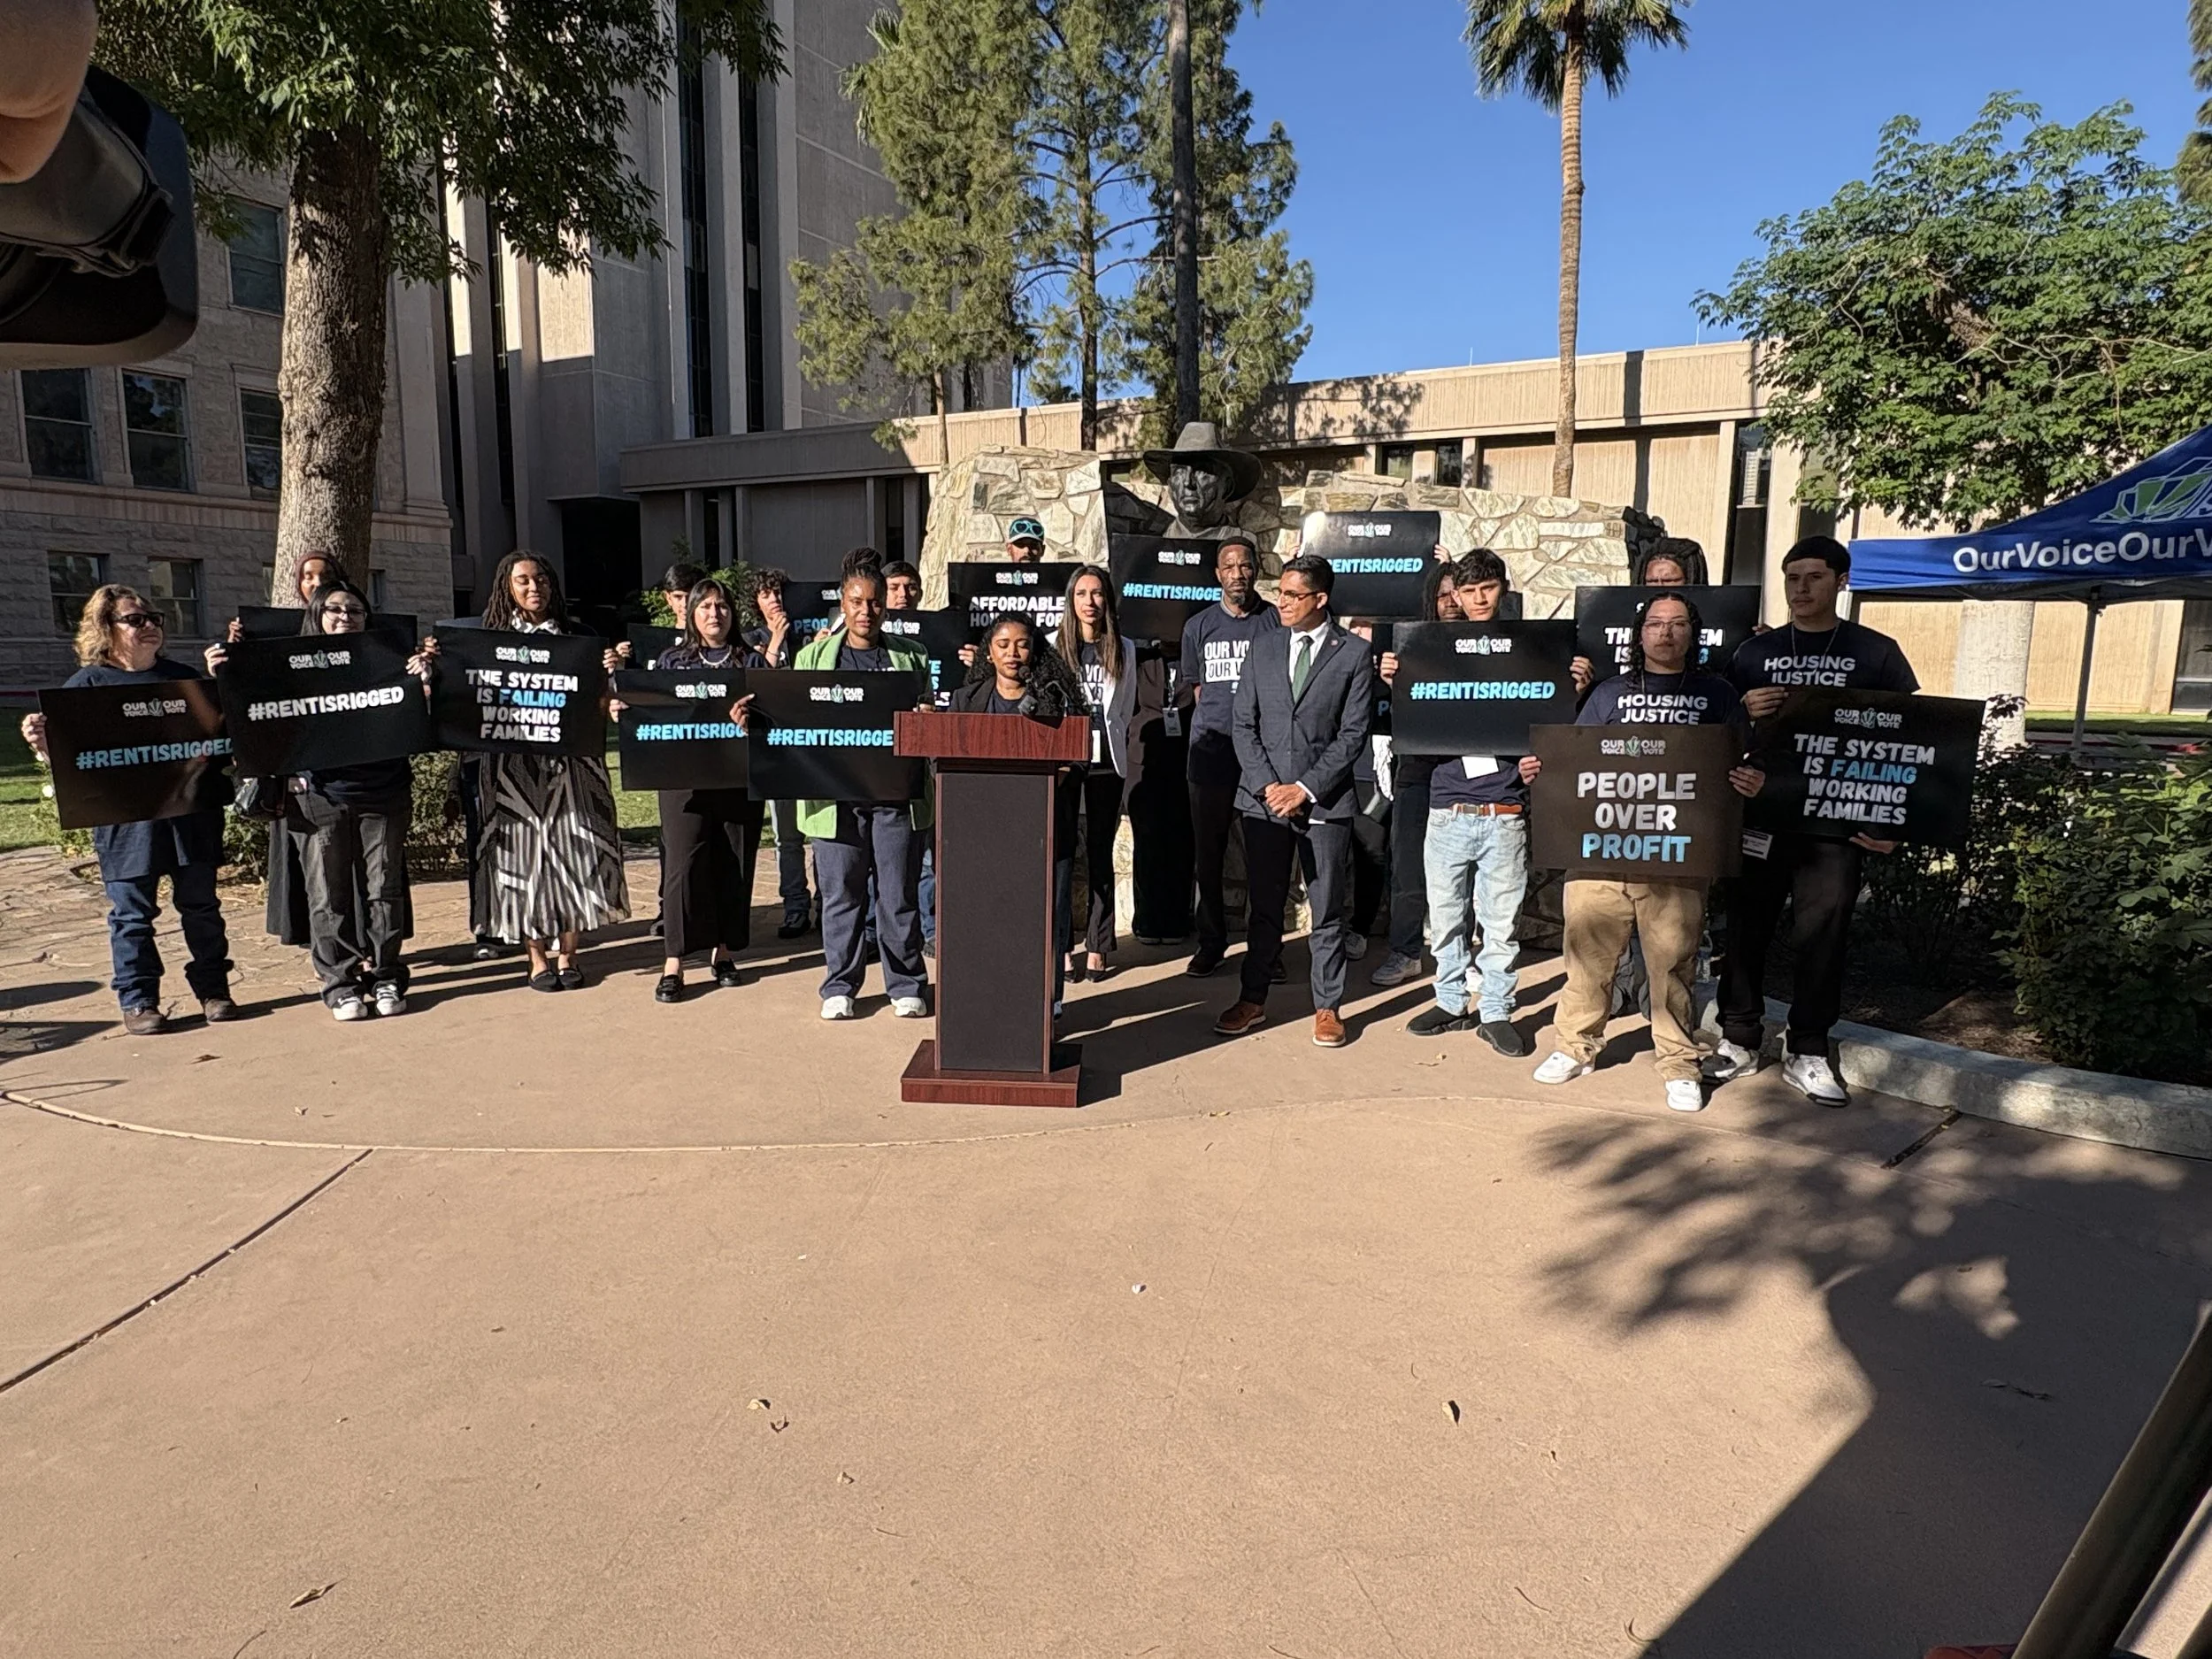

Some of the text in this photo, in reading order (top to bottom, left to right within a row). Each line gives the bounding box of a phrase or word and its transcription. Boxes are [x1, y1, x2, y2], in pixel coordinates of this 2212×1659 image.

[1953, 528, 2212, 572] OurVoiceOurV
[1327, 558, 1423, 573] ENTISRIGGED
[1123, 583, 1222, 601] #RENTISRIGGE
[969, 596, 1065, 611] AFFORDABLE
[794, 618, 828, 634] PEOP
[1604, 627, 1632, 644] TH
[289, 655, 313, 664] OUR
[327, 651, 350, 660] OUR
[1204, 641, 1230, 660] OUR
[1209, 661, 1231, 679] OUR
[1764, 656, 1856, 671] HOUSING
[465, 670, 578, 692] THE SYSTEM
[477, 687, 566, 707] IS FAILING
[1410, 681, 1555, 700] #RENTISRIGGED
[122, 702, 147, 711] OUR
[163, 699, 187, 709] OUR
[248, 687, 404, 721] #RENTISRIGGED
[1617, 695, 1708, 710] HOUSING
[482, 706, 560, 725] WORKING
[1621, 710, 1701, 726] JUSTICE
[1835, 709, 1860, 718] OUR
[1877, 712, 1902, 723] OUR
[480, 724, 561, 742] FAMILIES
[637, 723, 745, 741] #RENTISRIGG
[767, 729, 894, 747] #RENTISRIGGE
[1601, 740, 1624, 749] OUR
[1641, 740, 1666, 749] OUR
[1794, 733, 1936, 765] THE SYSTEM
[1803, 756, 1917, 784] IS FAILING
[1578, 772, 1697, 801] PEOPLE
[1809, 778, 1907, 804] WORKING
[1595, 802, 1677, 832] OVER
[1803, 798, 1907, 825] FAMILIES
[1582, 833, 1692, 863] PROFIT
